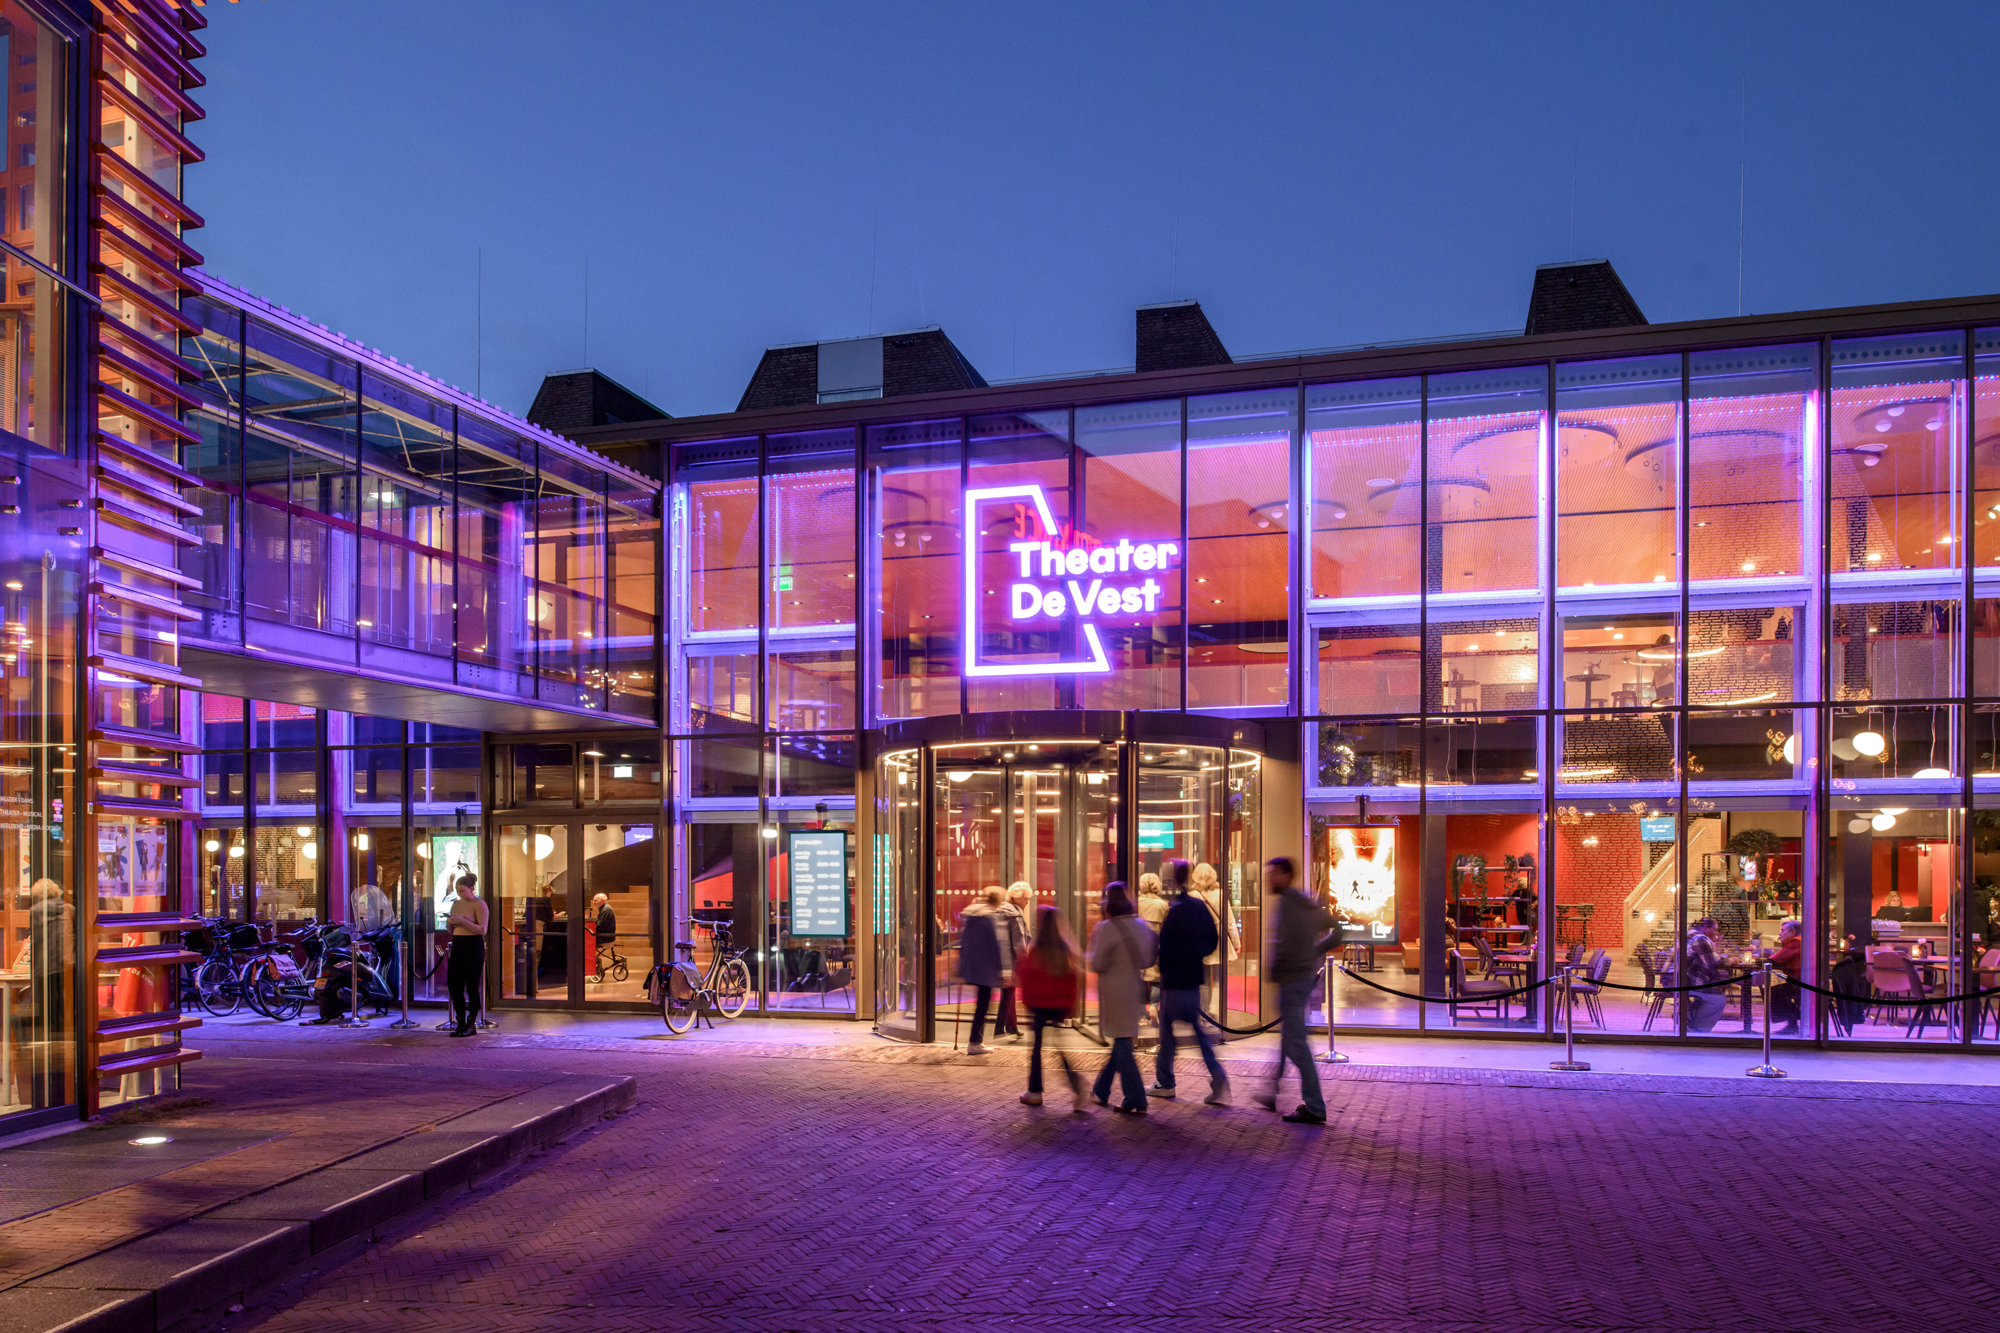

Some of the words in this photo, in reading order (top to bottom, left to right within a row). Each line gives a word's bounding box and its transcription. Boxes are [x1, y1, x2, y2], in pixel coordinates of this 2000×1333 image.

[1010, 539, 1178, 577] Theater
[1011, 583, 1066, 619] De
[1067, 579, 1160, 616] Vest
